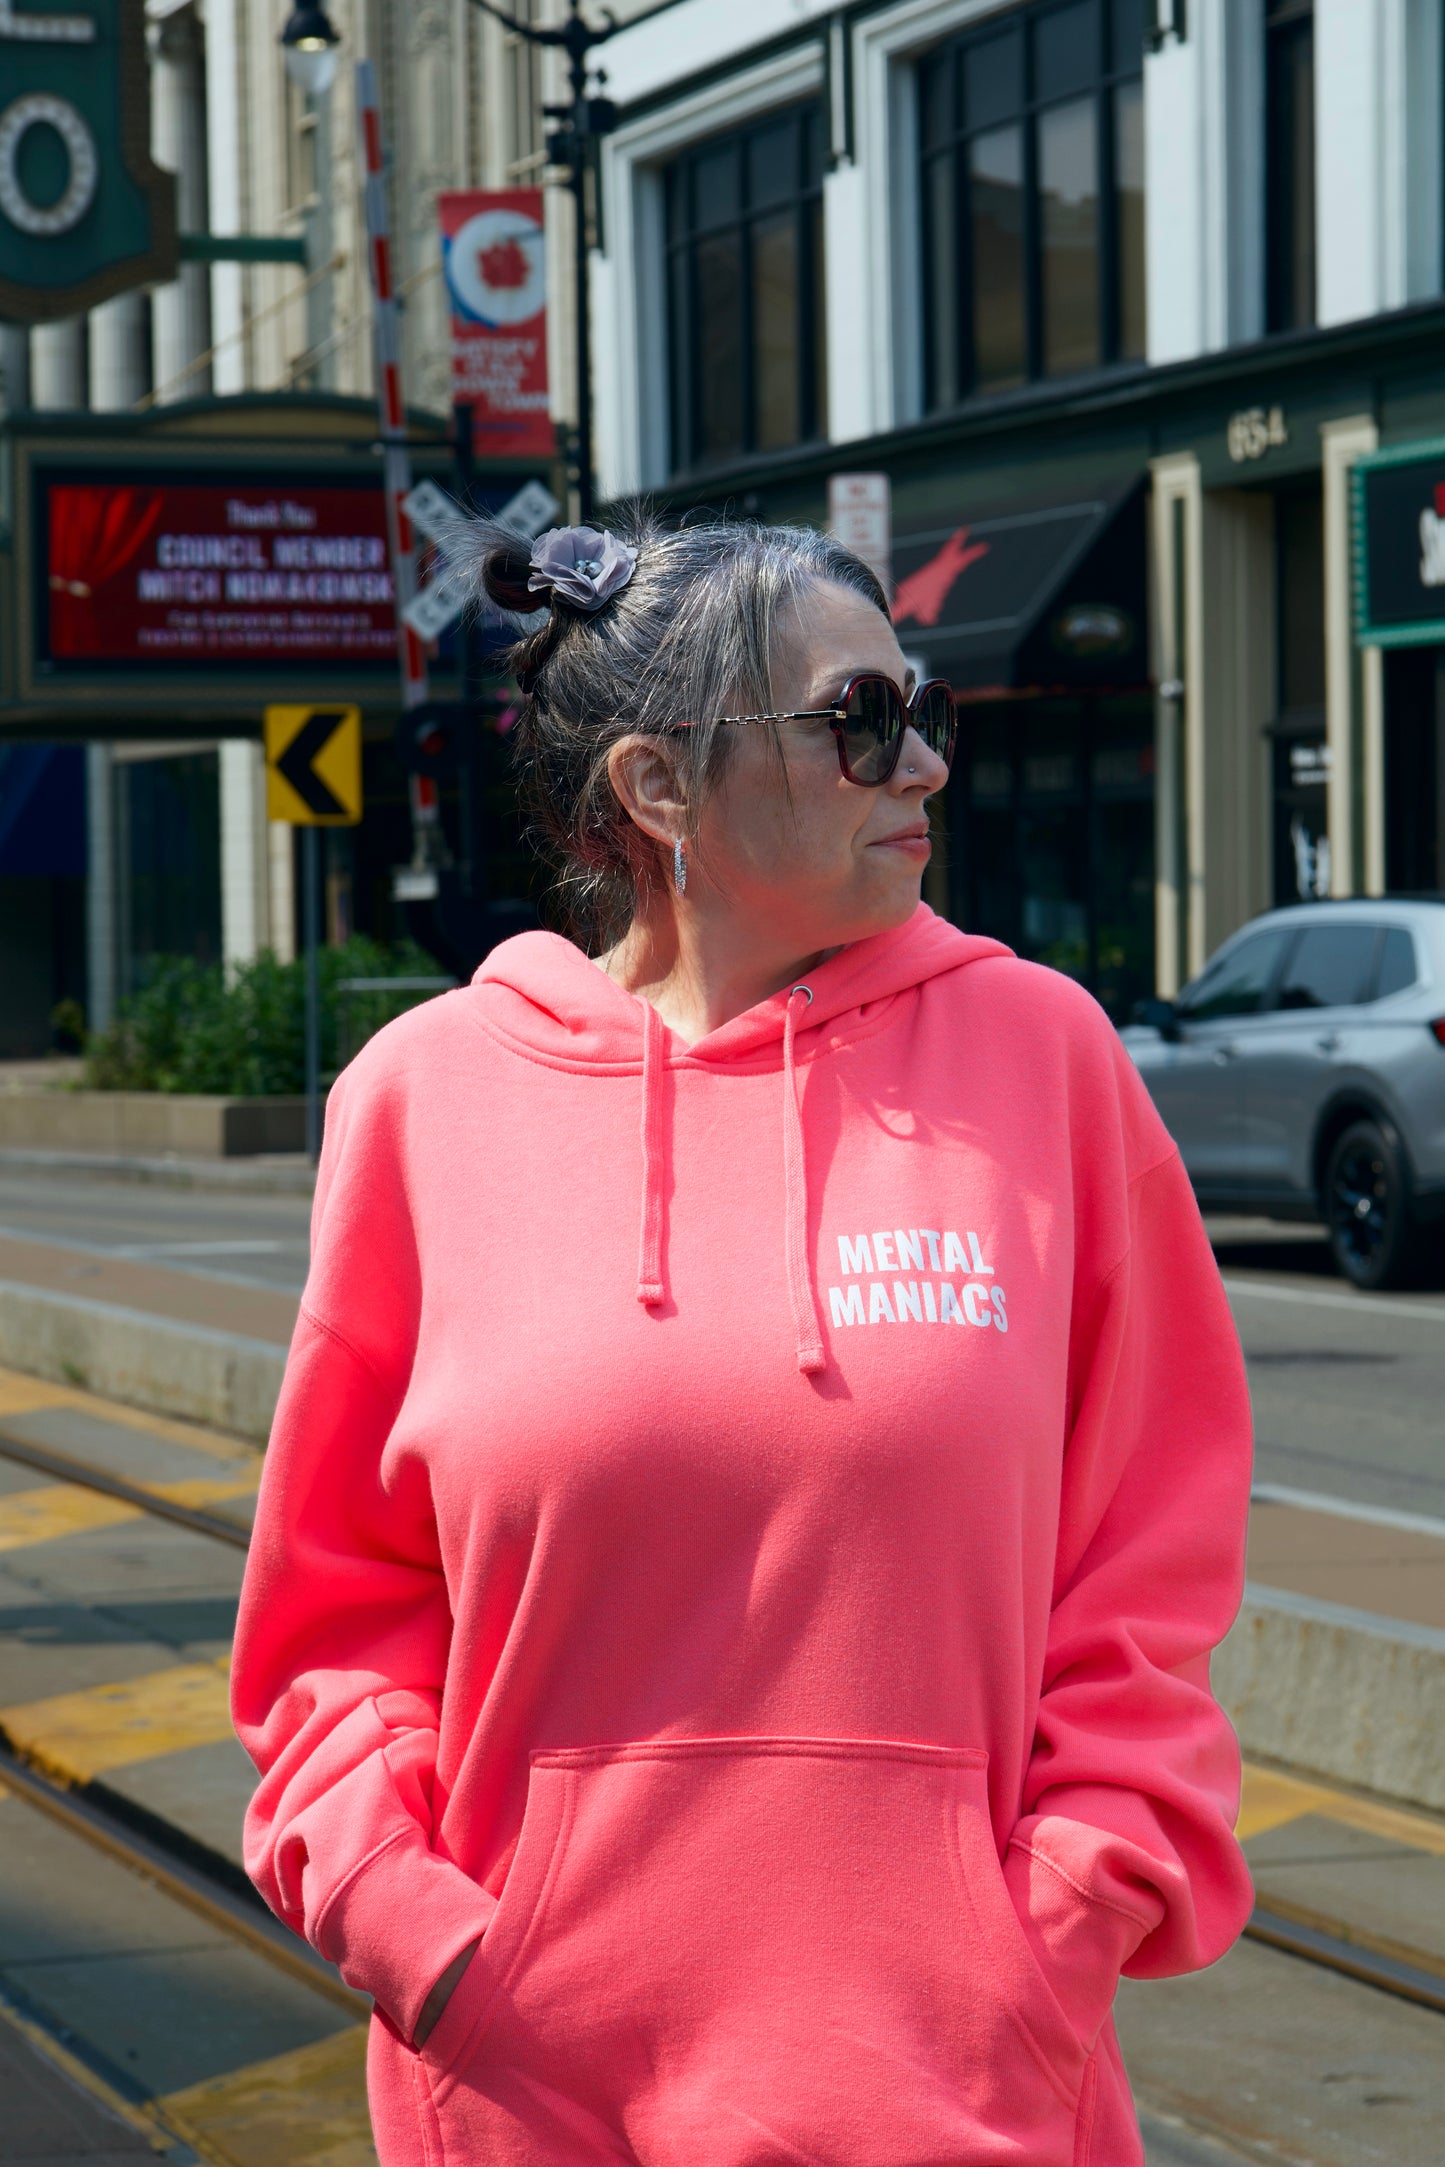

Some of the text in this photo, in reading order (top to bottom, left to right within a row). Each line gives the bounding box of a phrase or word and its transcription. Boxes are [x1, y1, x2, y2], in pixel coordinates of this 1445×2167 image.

[1227, 407, 1288, 462] 654
[227, 501, 281, 527] Thank
[158, 536, 384, 568] COUNCIL MEMBER
[139, 571, 394, 602] MITCH NOWAKOWSK
[837, 1228, 995, 1275] MENTAL
[828, 1281, 1008, 1333] MANIACS
